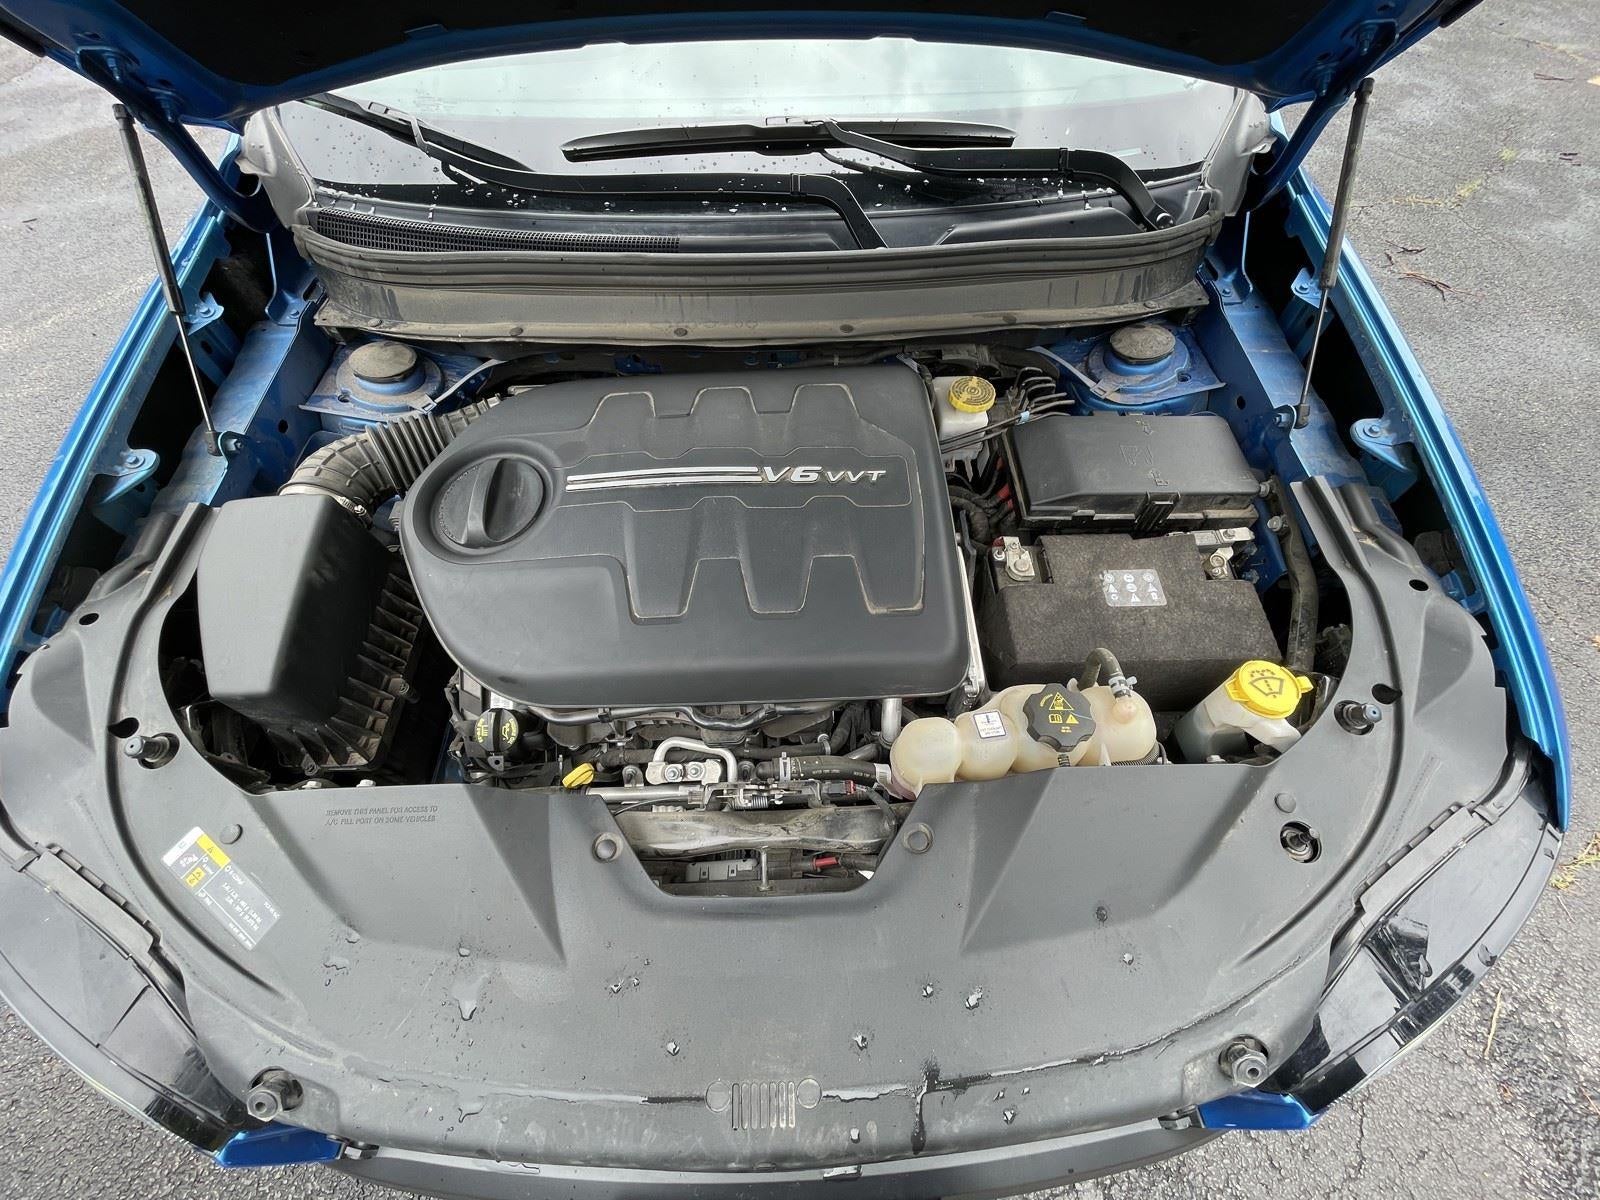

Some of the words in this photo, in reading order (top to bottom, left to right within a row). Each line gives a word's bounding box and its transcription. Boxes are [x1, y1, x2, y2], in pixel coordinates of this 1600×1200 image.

[763, 466, 822, 483] V6
[827, 470, 886, 483] VVT
[326, 808, 352, 816] REMOVE
[369, 807, 388, 815] PANEL
[385, 816, 403, 824] SOME
[404, 815, 436, 823] VEHICLES
